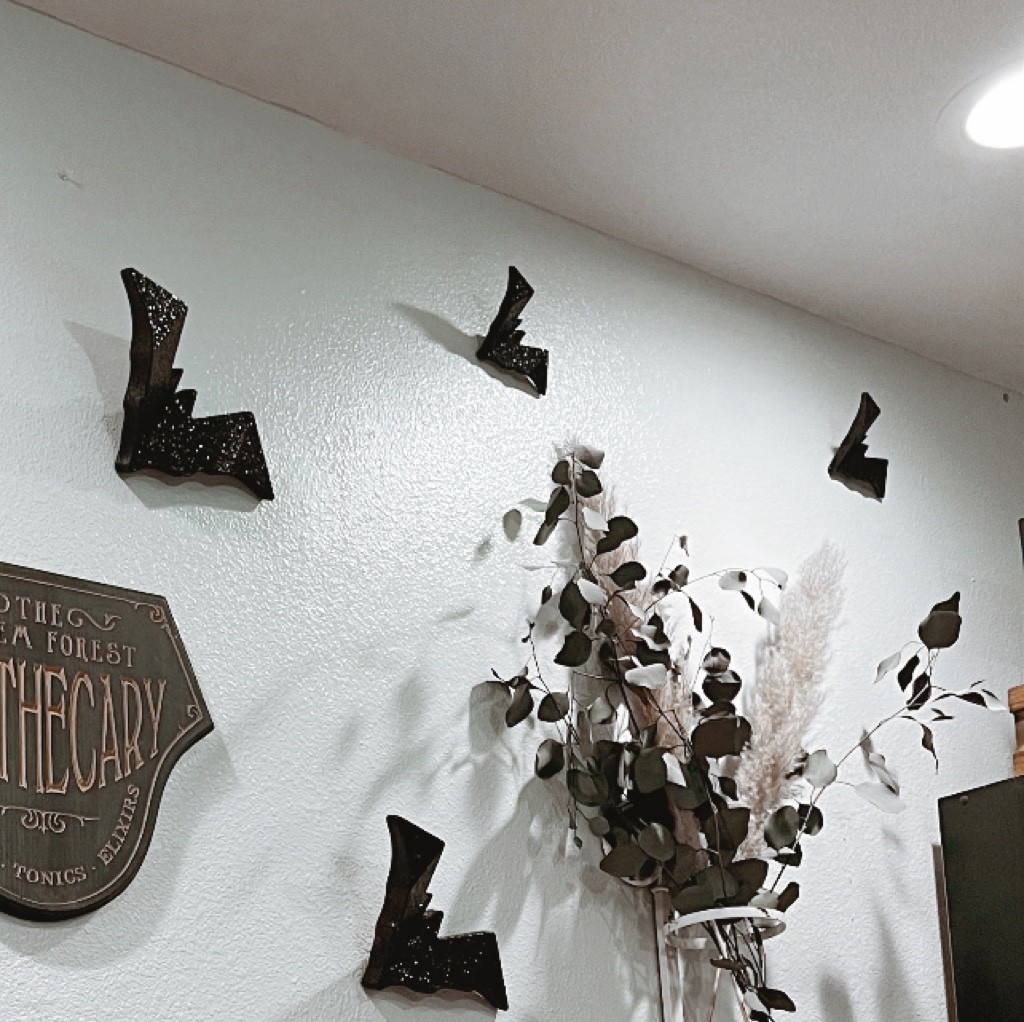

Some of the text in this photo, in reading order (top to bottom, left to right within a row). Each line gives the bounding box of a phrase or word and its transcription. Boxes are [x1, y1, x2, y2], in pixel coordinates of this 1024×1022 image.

[15, 595, 64, 628] THE
[47, 631, 137, 668] FOREST
[13, 862, 88, 887] TONICS
[97, 783, 141, 867] ELIXIRS
